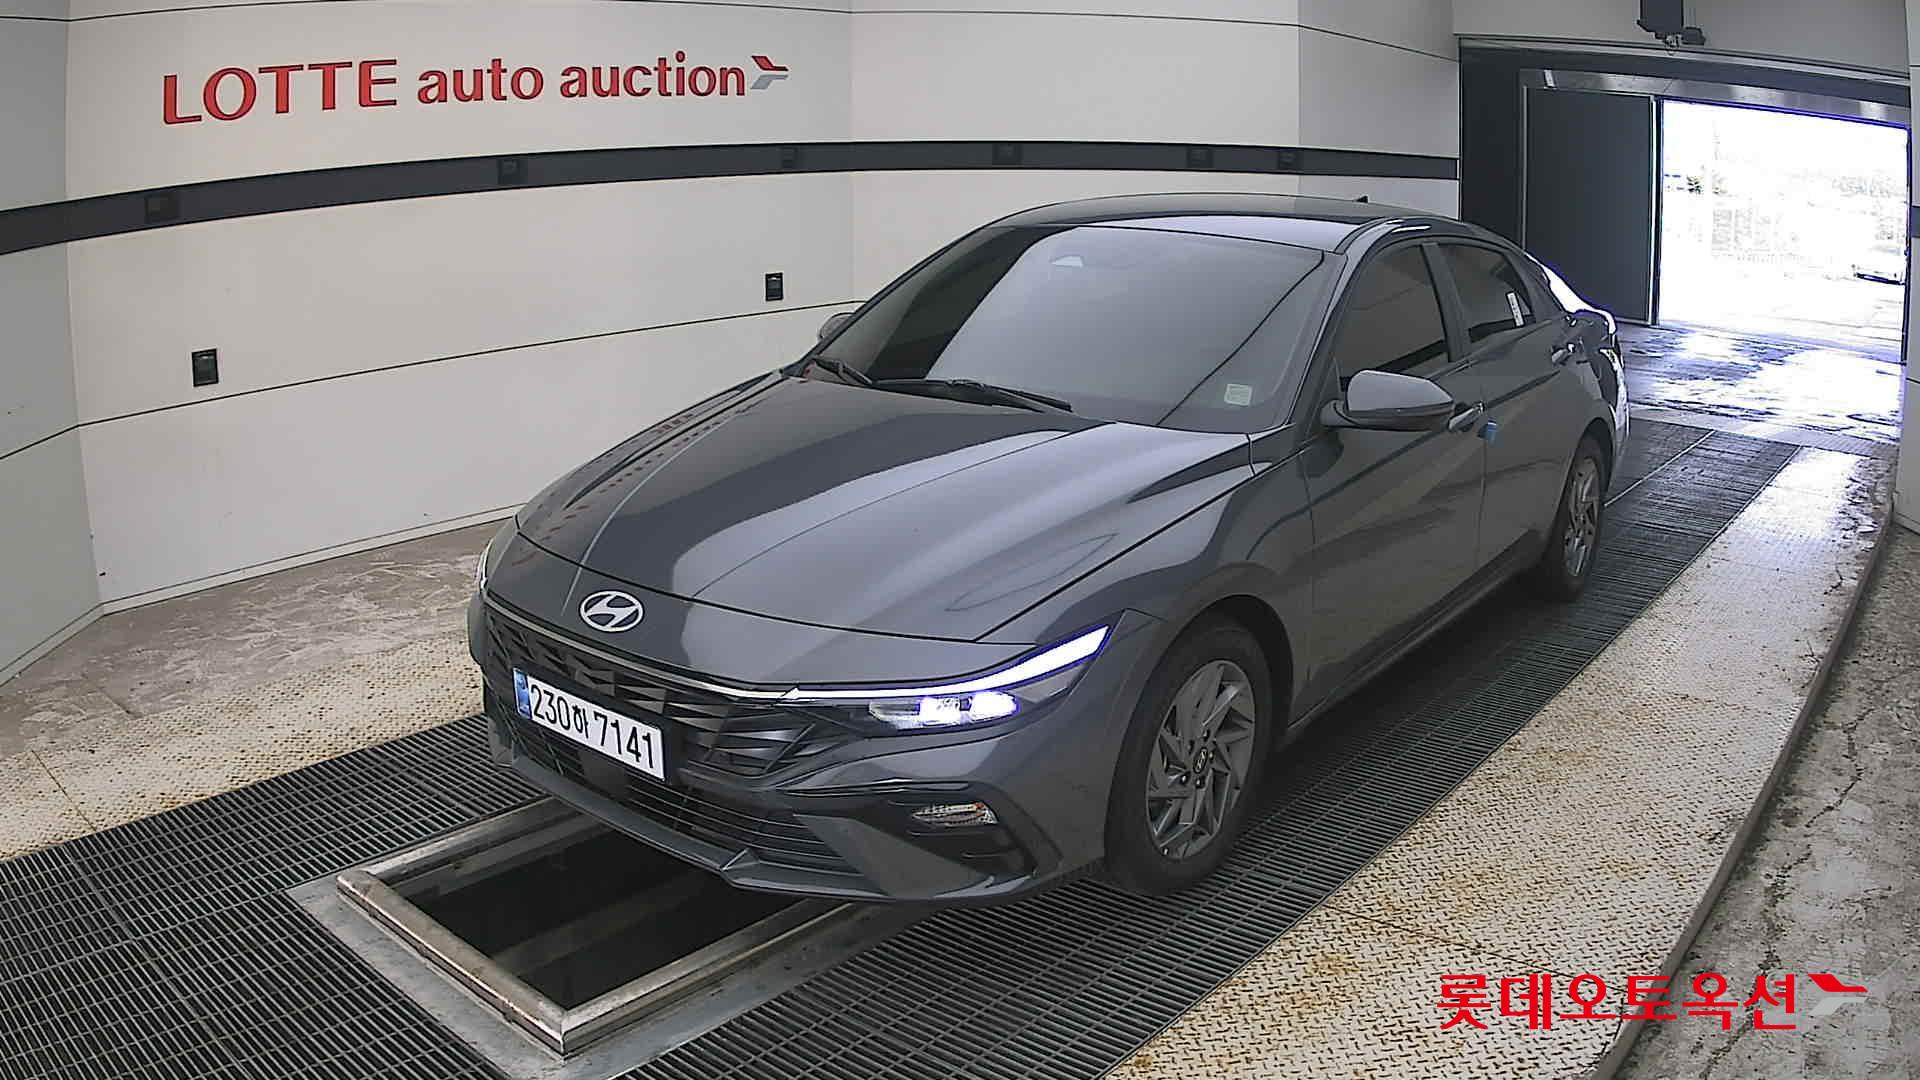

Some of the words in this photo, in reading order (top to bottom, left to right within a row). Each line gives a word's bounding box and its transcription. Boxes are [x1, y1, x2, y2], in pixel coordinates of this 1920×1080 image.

[163, 59, 398, 124] LOTTE
[417, 58, 545, 104] auto
[559, 51, 746, 98] auction
[594, 711, 654, 769] 7141
